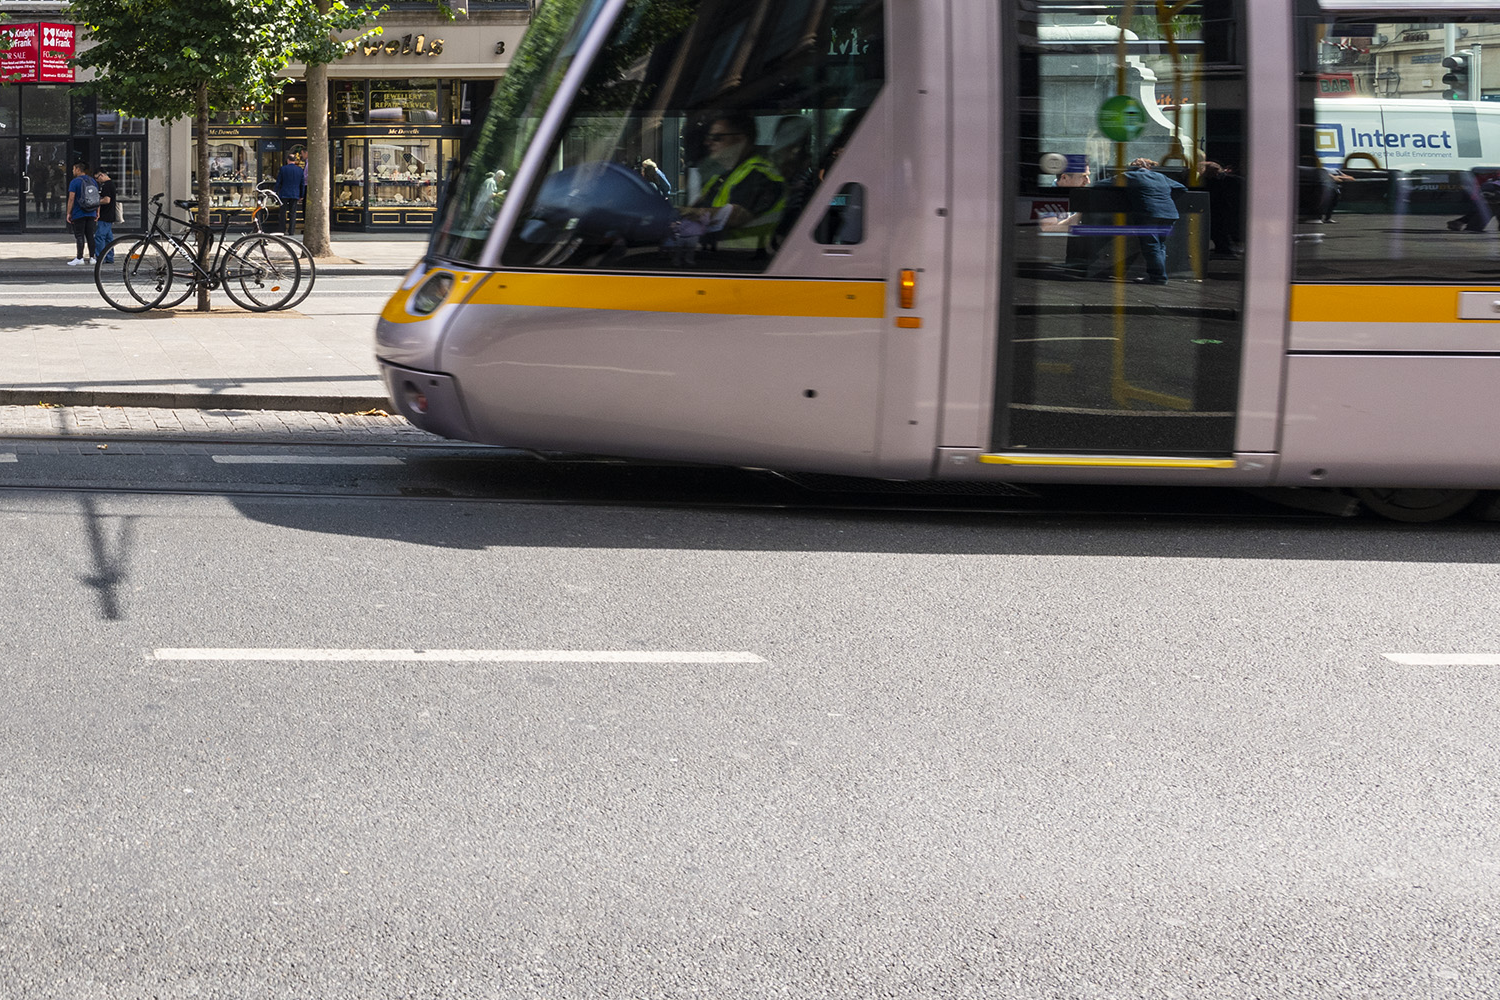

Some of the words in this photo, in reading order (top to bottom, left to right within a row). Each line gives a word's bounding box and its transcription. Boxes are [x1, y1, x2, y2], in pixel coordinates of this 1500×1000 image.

[15, 28, 35, 39] Knight
[55, 28, 73, 40] Knight
[14, 39, 32, 48] Frank
[55, 39, 71, 48] Frank
[494, 41, 506, 55] 3
[1319, 78, 1352, 93] BAR
[383, 93, 422, 101] JEWELLERY
[1351, 127, 1452, 149] Interact
[1395, 150, 1411, 158] Built
[1412, 151, 1453, 159] Environment
